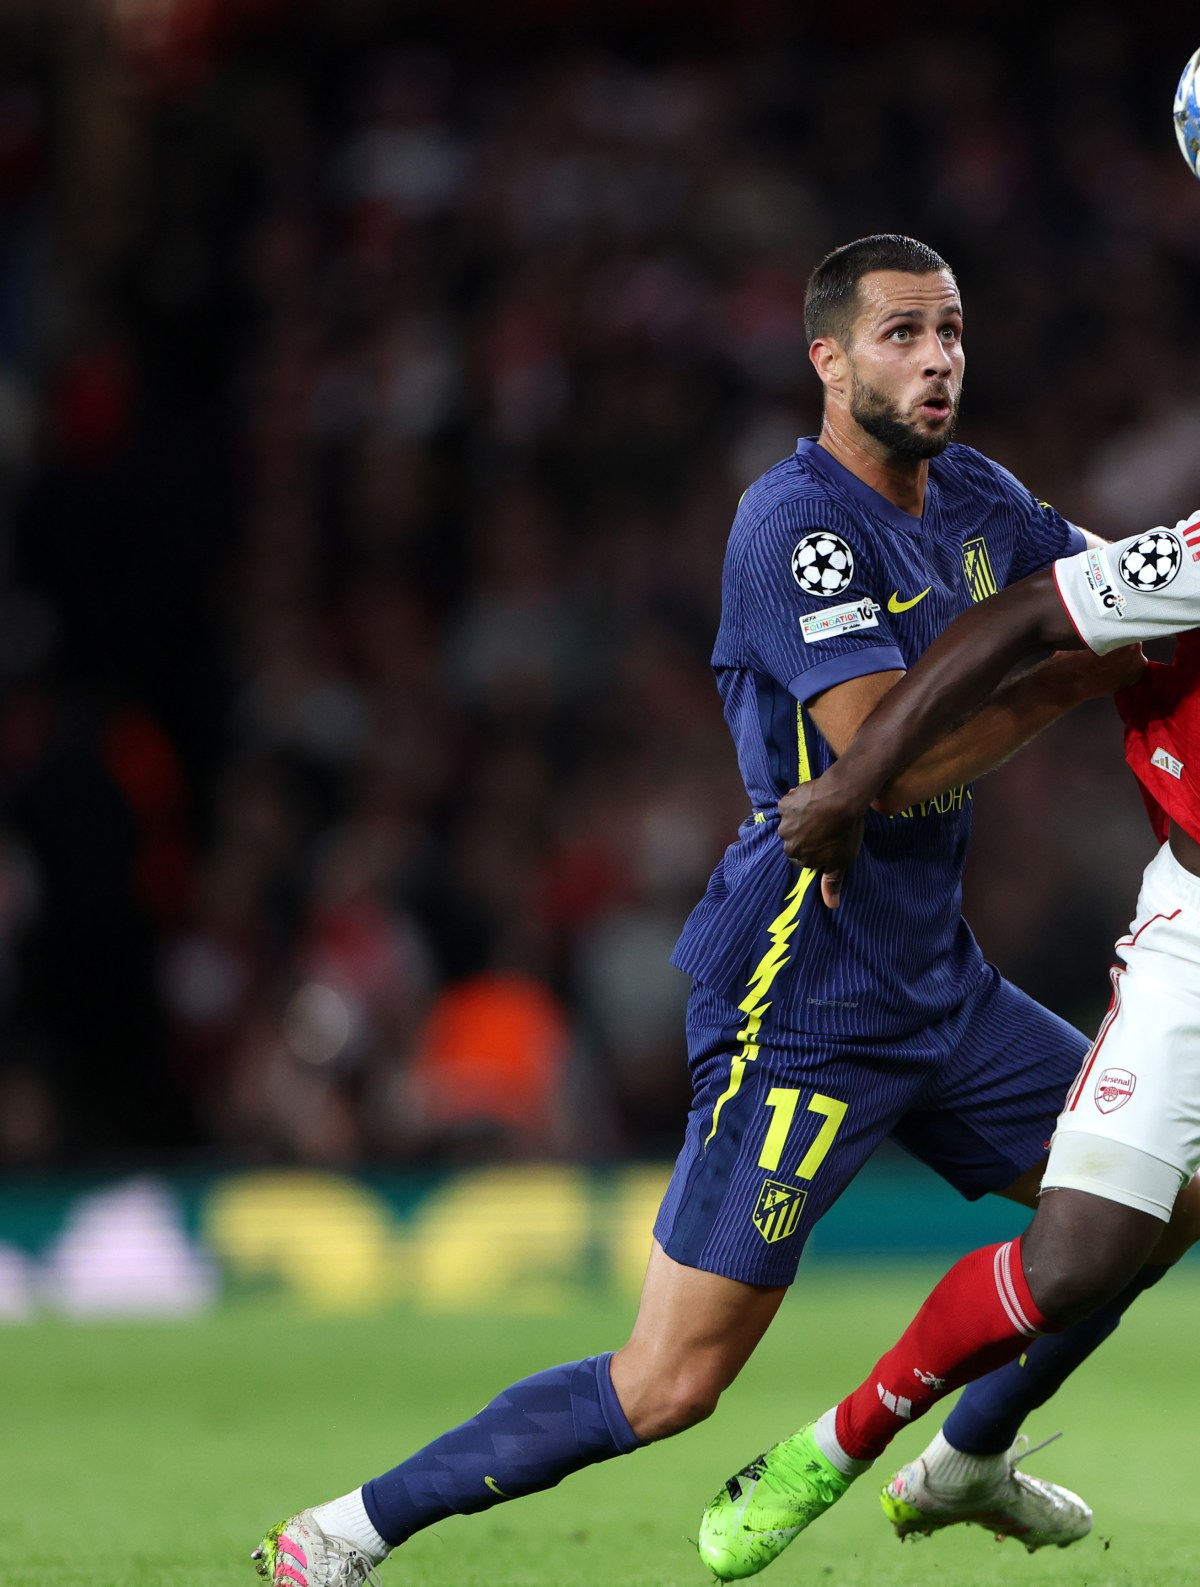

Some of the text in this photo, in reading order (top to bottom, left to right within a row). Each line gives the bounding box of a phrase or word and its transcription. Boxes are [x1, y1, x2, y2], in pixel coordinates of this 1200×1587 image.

[1099, 585, 1116, 608] 10
[804, 612, 859, 633] FOUNDATION
[857, 606, 873, 621] 10
[1102, 1074, 1130, 1087] Arsenal
[758, 1087, 849, 1181] 17
